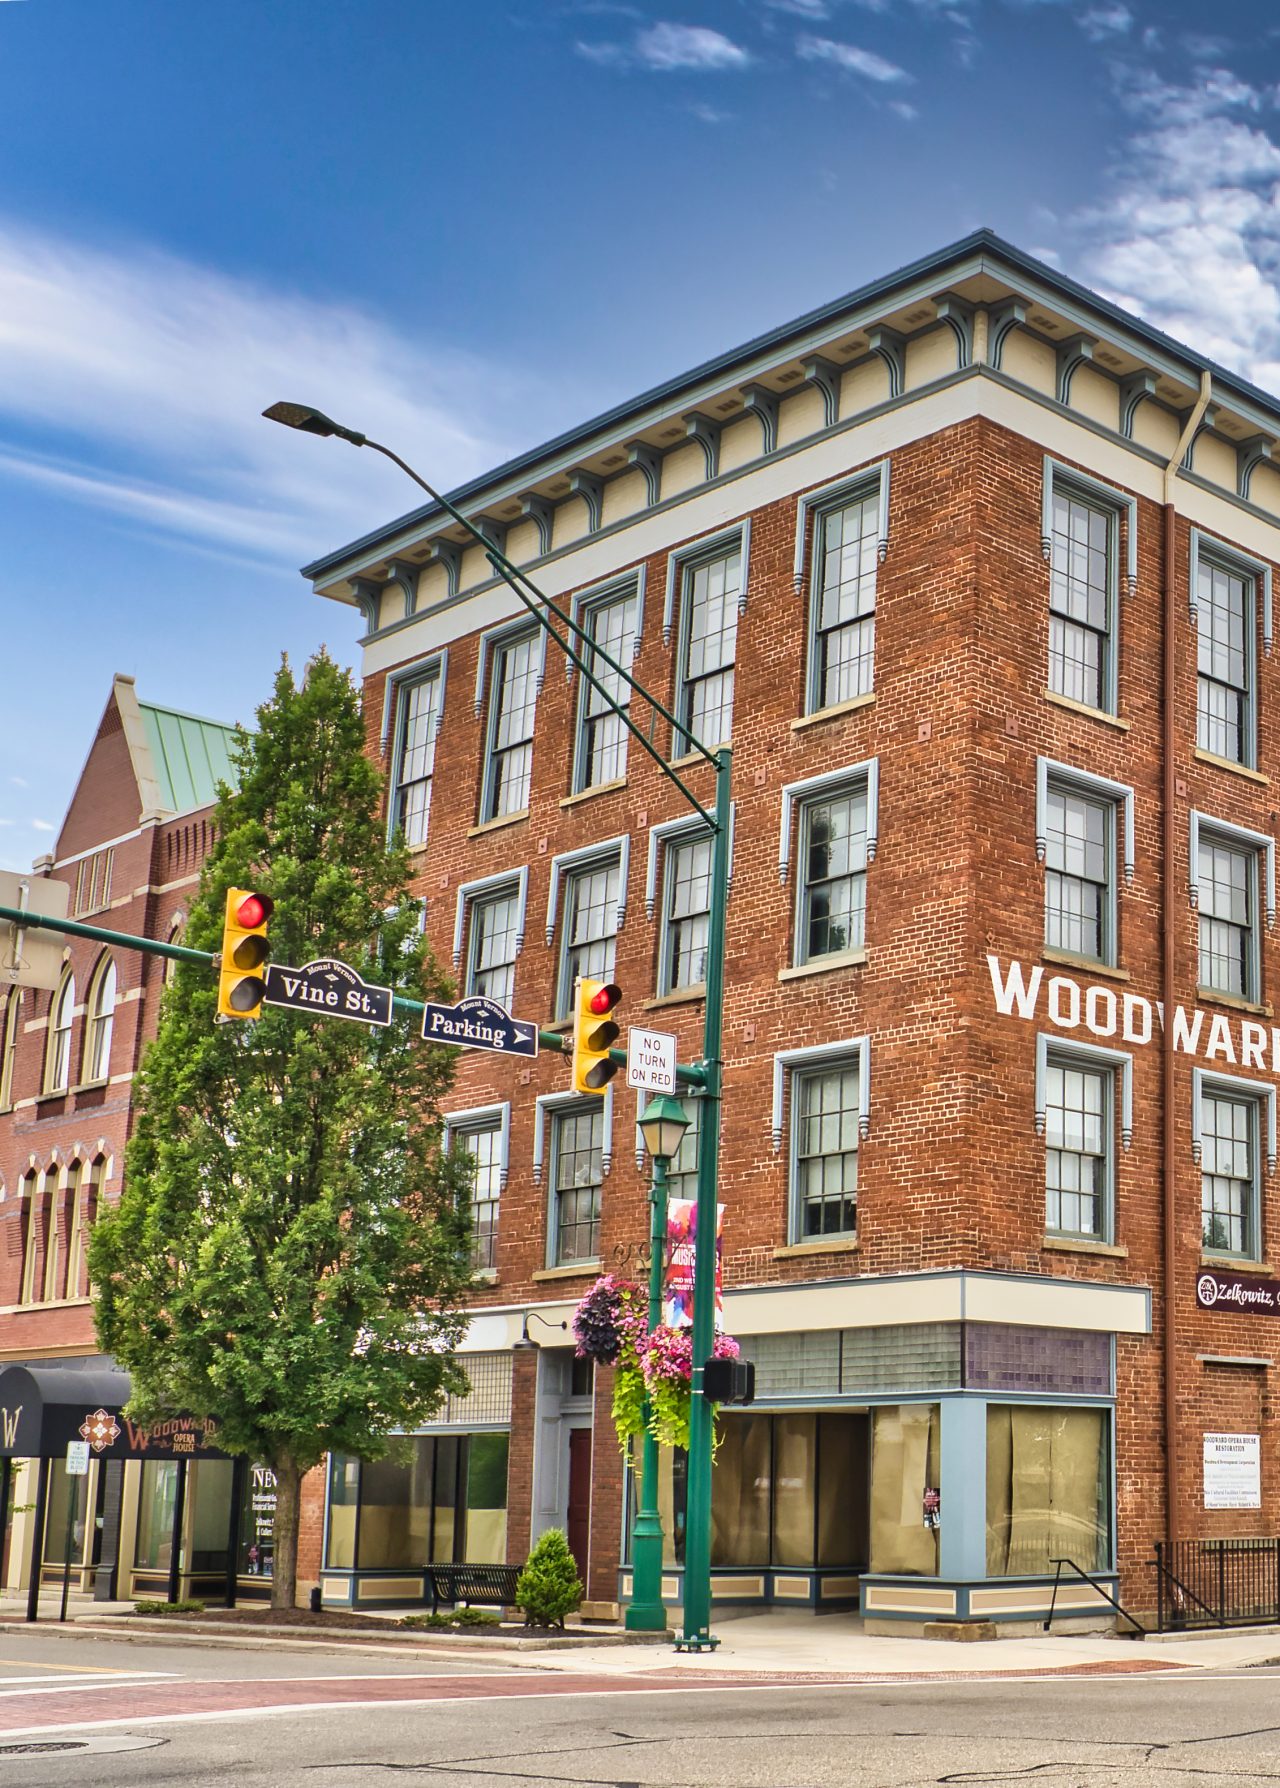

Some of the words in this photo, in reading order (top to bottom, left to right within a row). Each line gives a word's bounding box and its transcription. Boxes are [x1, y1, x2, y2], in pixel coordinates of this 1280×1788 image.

[306, 963, 331, 975] Mount
[333, 963, 356, 985] Vernon
[282, 977, 338, 1006] Vine
[346, 990, 377, 1014] St.
[461, 1001, 482, 1012] Mount
[483, 1001, 505, 1020] Vernon
[430, 1013, 506, 1048] Parking
[644, 1037, 660, 1051] NO
[639, 1052, 666, 1068] TURN
[632, 1068, 645, 1081] ON
[651, 1072, 671, 1085] RED
[1217, 1284, 1274, 1306] Zelkowitz,
[1, 1406, 23, 1448] W
[172, 1442, 195, 1453] HOUSE
[173, 1433, 195, 1443] OPERA
